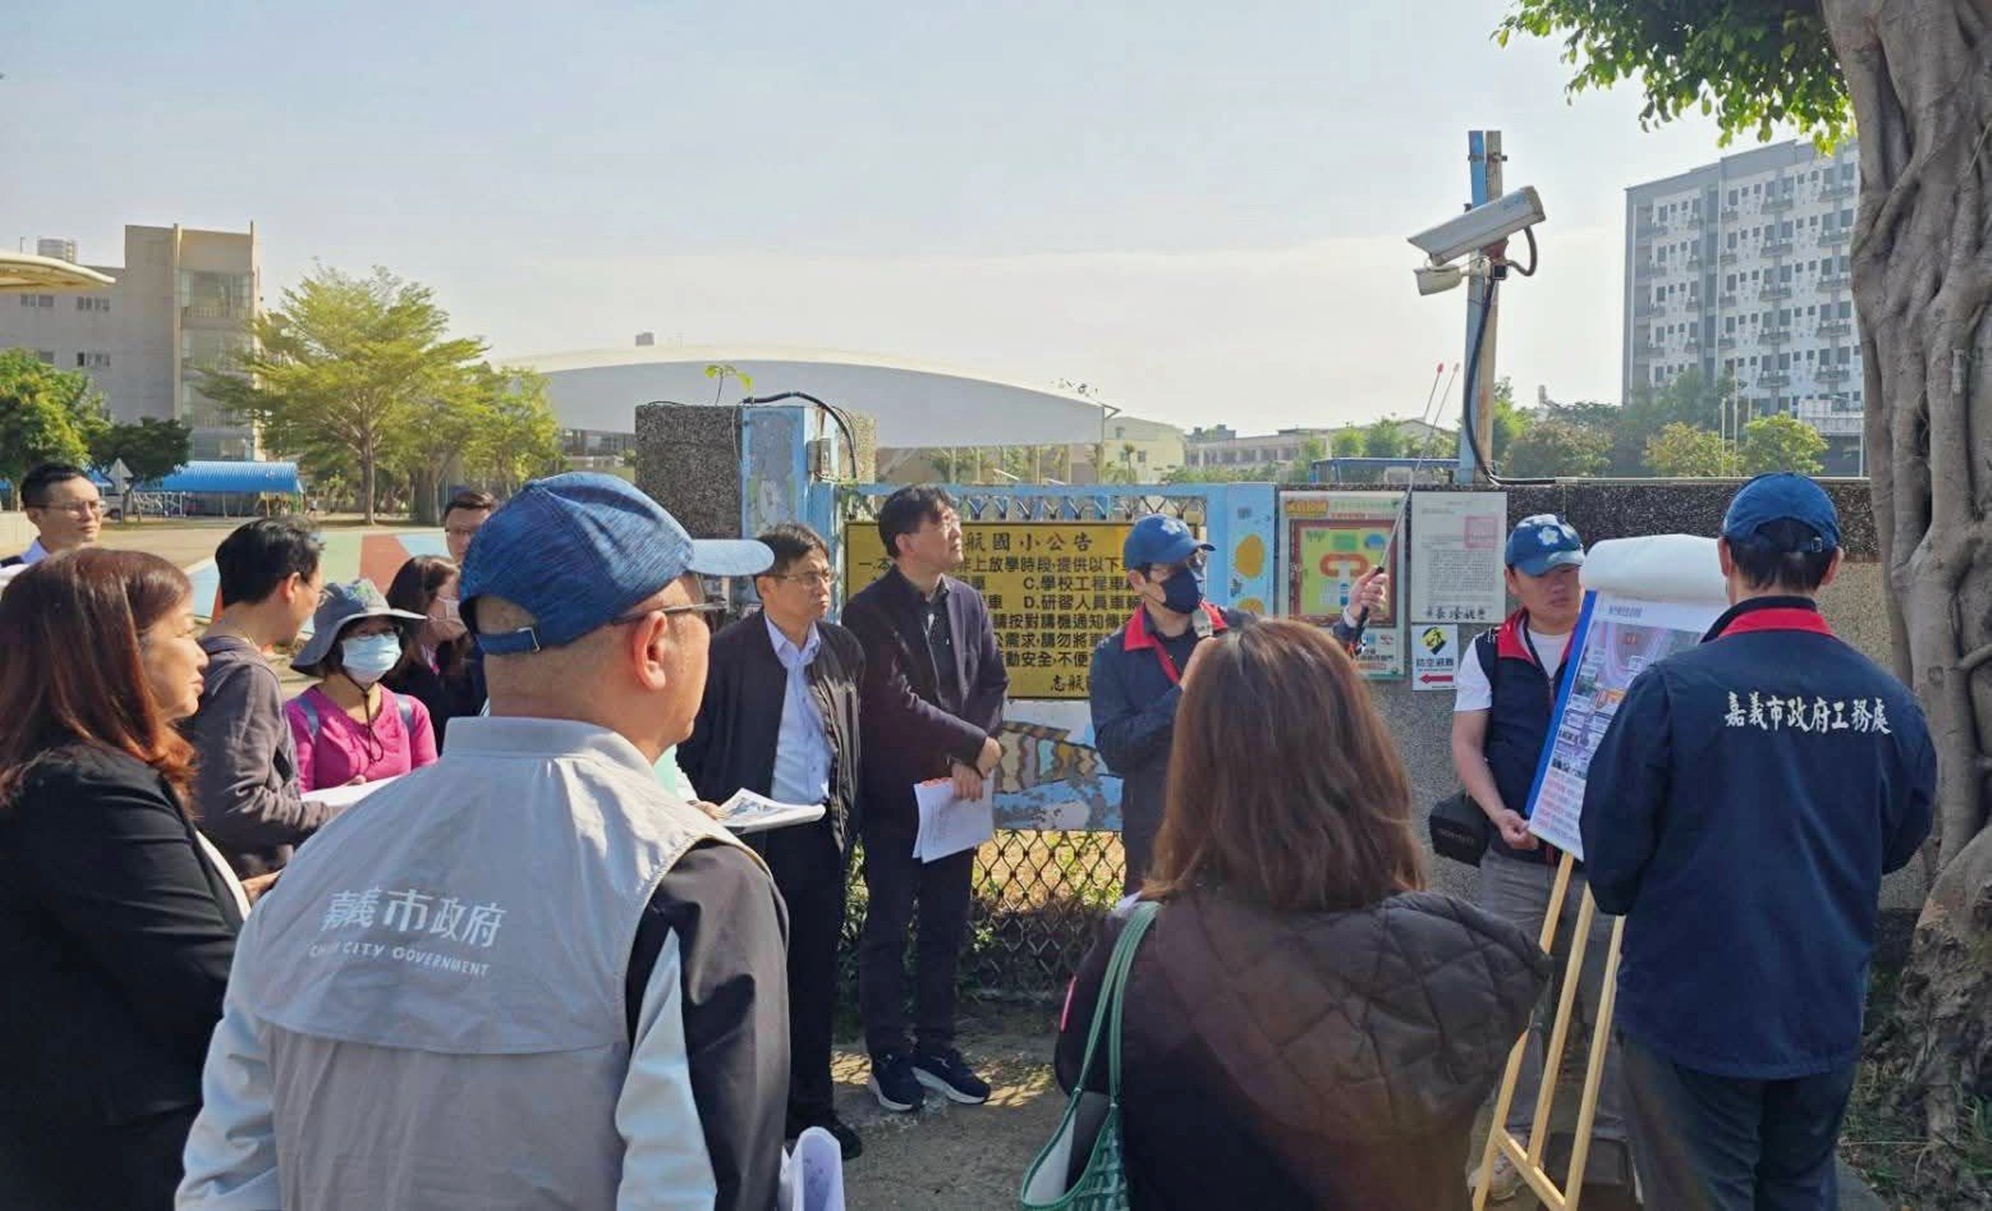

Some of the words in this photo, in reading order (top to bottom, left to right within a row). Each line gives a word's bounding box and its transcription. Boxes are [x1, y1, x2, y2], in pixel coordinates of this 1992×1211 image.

[964, 531, 1093, 552] 航國小公告
[1001, 651, 1091, 668] 動安全，不便
[1050, 674, 1090, 692] 志航
[1724, 690, 1892, 735] 嘉義市政府工務處
[342, 940, 387, 959] CITY
[392, 946, 490, 977] GOVERNMENT
